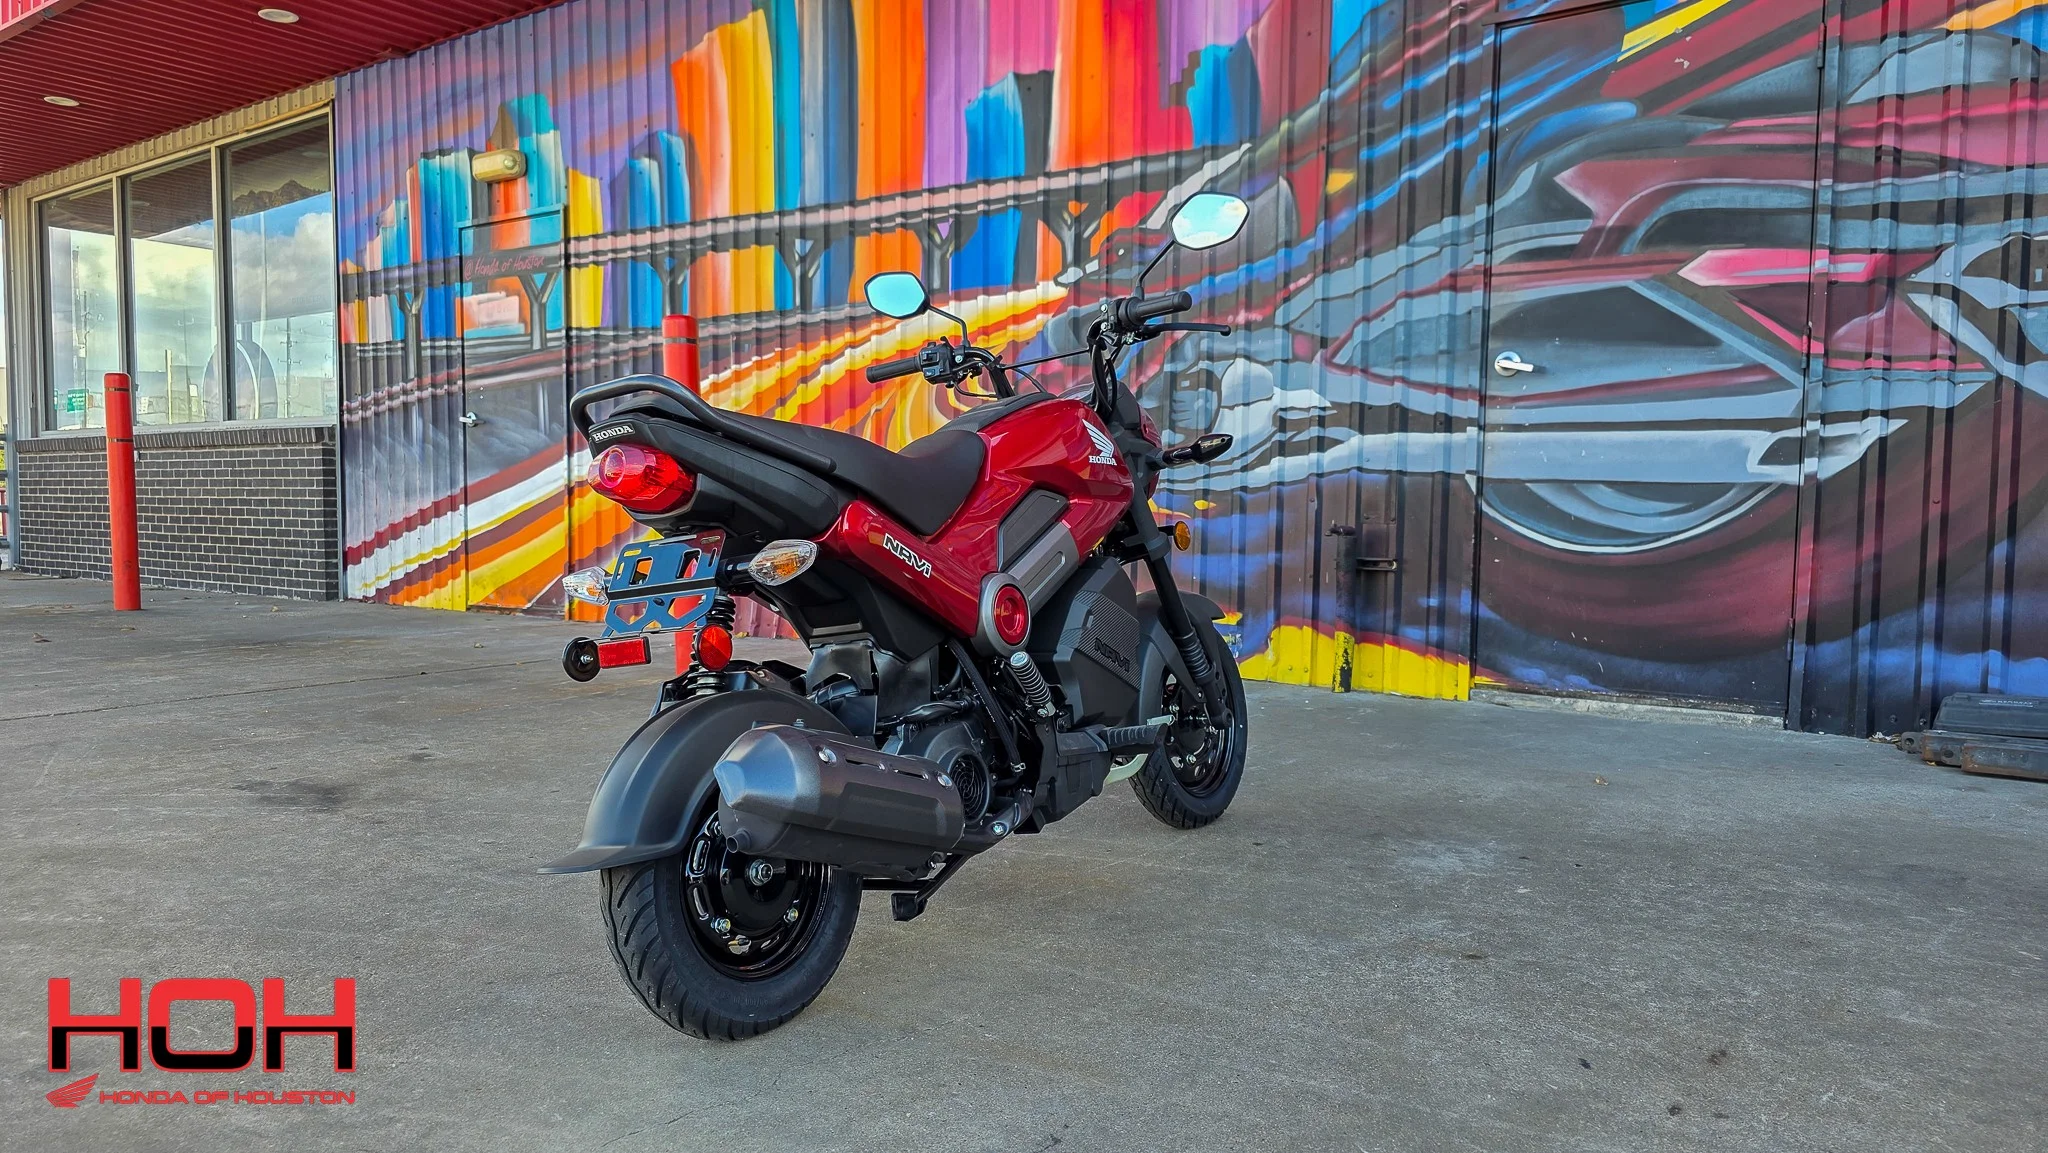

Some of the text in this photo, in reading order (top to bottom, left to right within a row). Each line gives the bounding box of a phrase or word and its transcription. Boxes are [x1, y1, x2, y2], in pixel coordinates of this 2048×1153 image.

[502, 259, 513, 272] of
[592, 425, 633, 441] HONDA
[1088, 455, 1117, 466] HONDA
